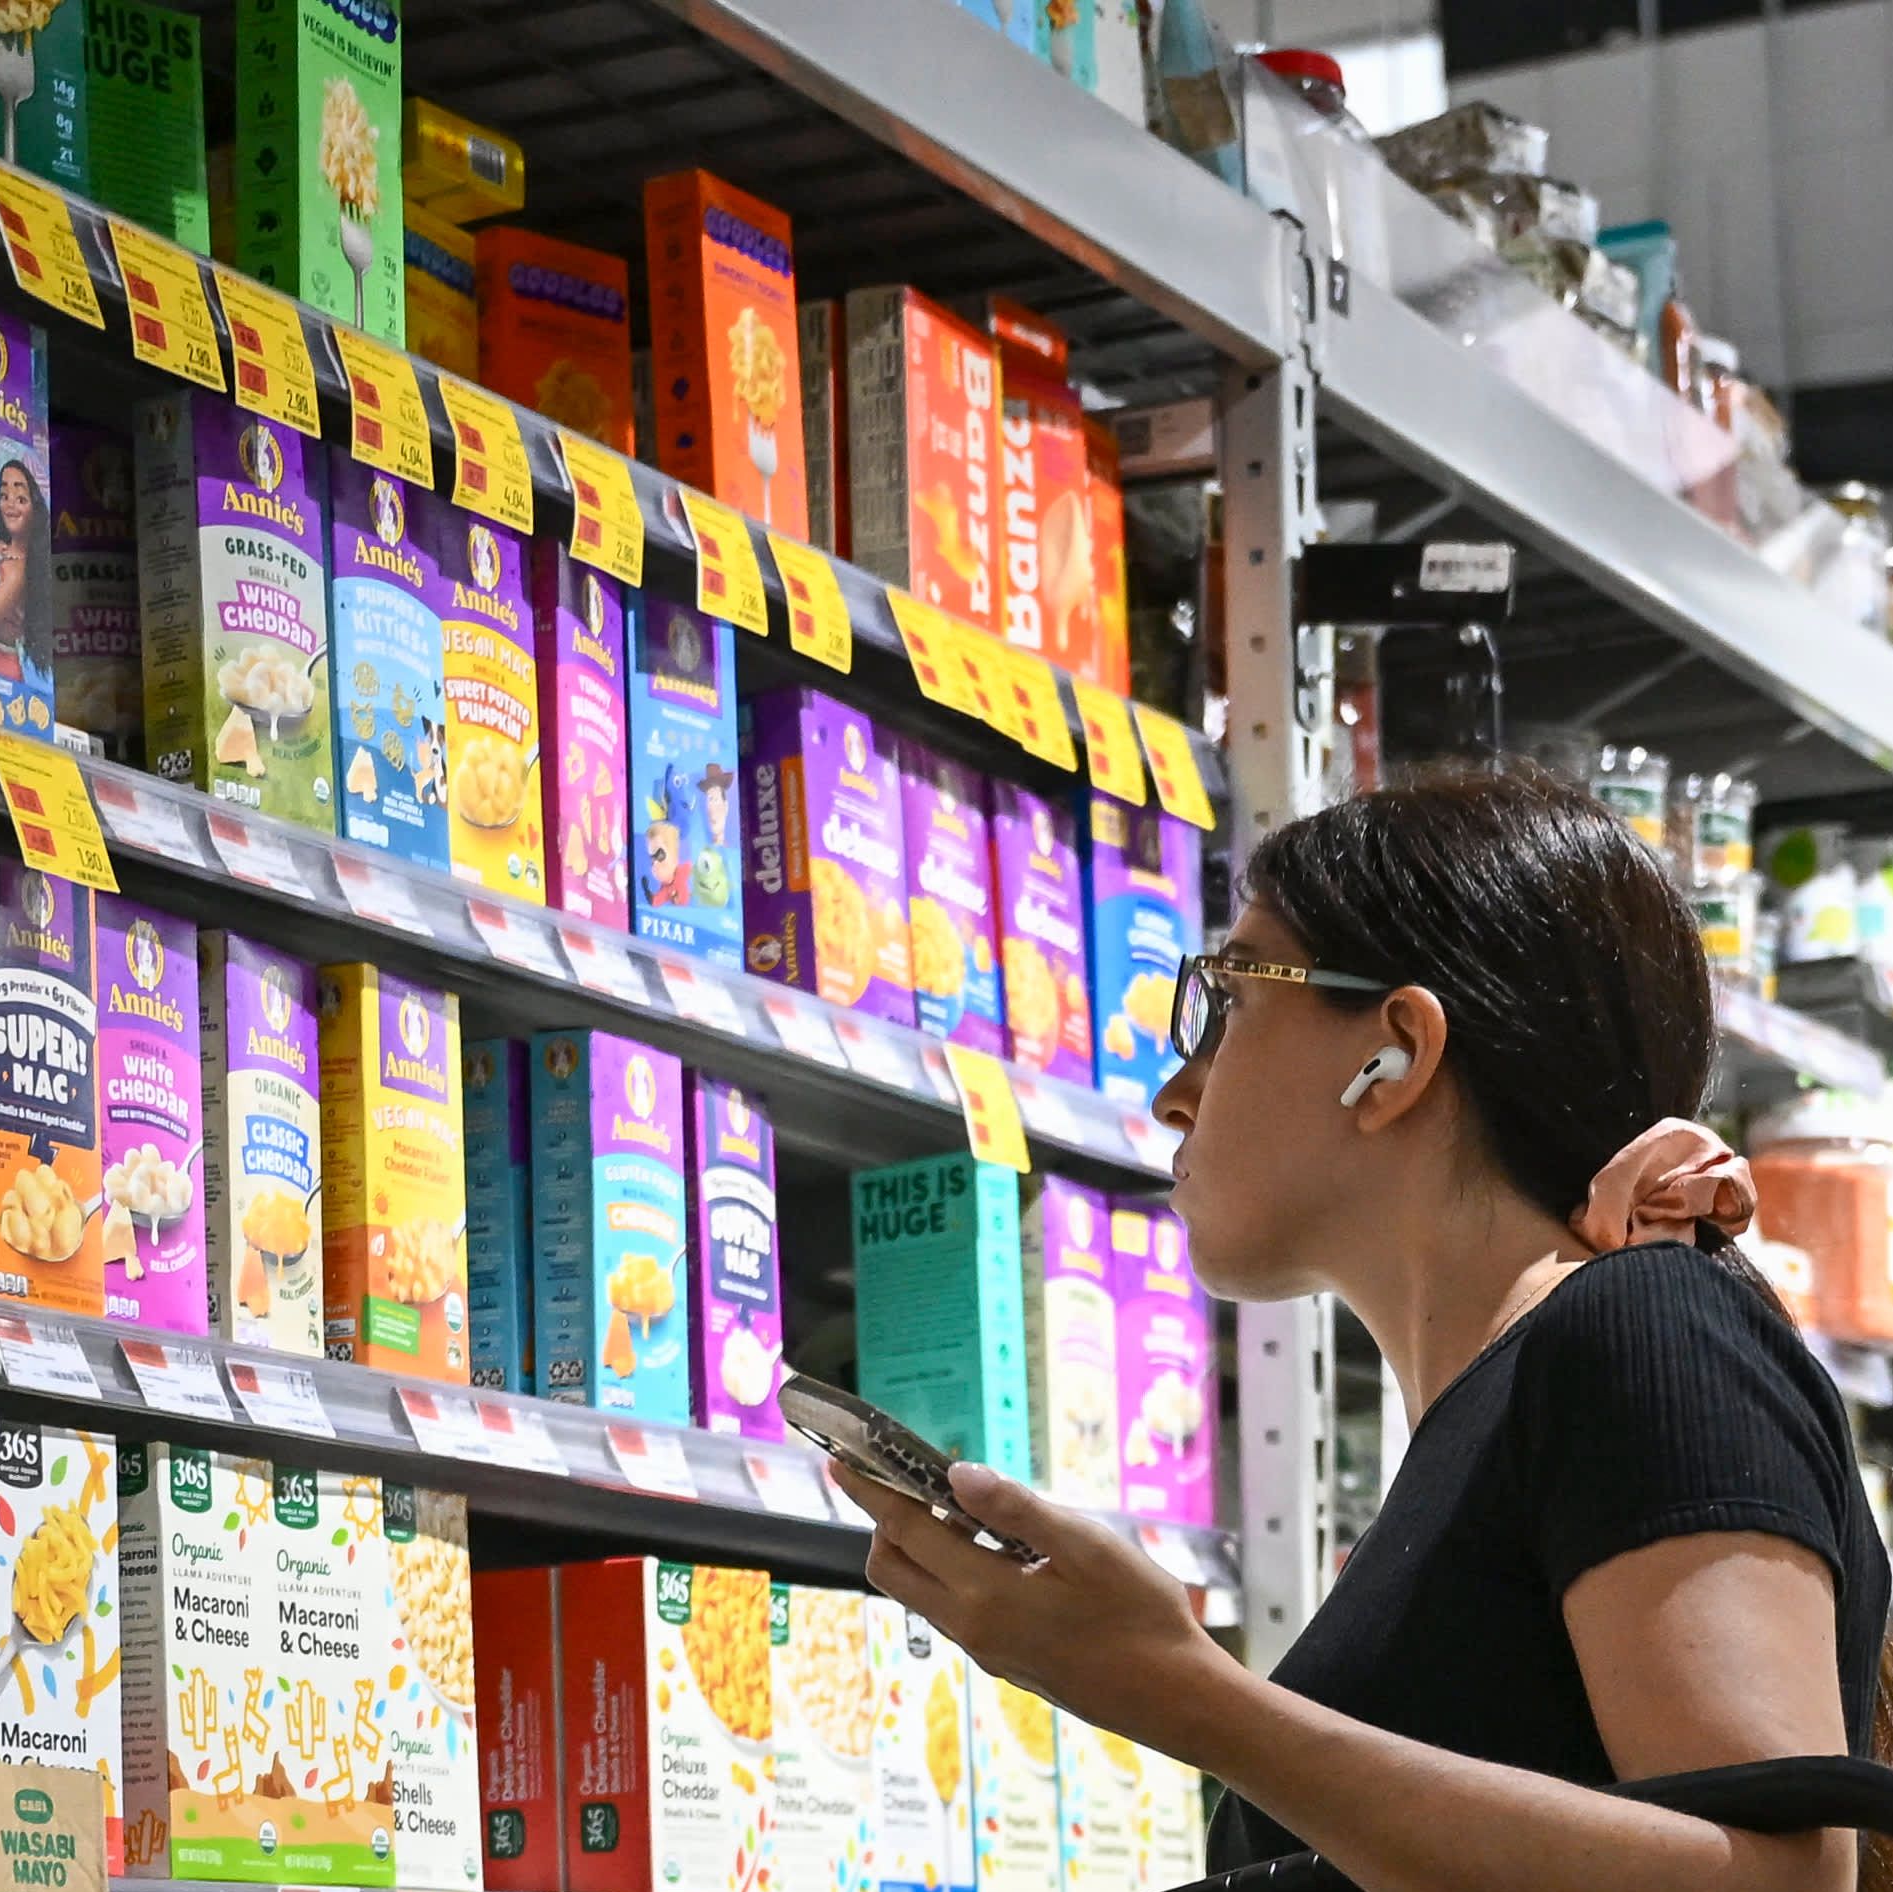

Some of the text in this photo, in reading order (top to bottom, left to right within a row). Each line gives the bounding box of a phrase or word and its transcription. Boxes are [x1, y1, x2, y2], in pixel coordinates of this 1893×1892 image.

[303, 13, 334, 43] VEGAN
[400, 442, 424, 467] 4.04
[504, 485, 526, 509] 4.04
[963, 347, 991, 615] Banza
[223, 482, 305, 537] Annie's
[1004, 397, 1042, 651] Banza
[225, 536, 308, 580] GRASS-FED
[356, 536, 424, 589] Annie's
[453, 583, 519, 631] Annie's
[443, 629, 533, 679] VEGAN MAC
[445, 677, 487, 705] SWEET
[487, 685, 532, 728] POTATO
[8, 921, 72, 963] Annie's
[641, 918, 696, 945] PIXAR
[107, 984, 184, 1034] Annie's
[246, 1030, 307, 1075] Annie's
[13, 1063, 69, 1105] MAC
[860, 1164, 967, 1212] THIS IS
[860, 1204, 947, 1247] HUGE
[0, 1429, 39, 1464] 365
[174, 1457, 208, 1490] 365
[172, 1533, 224, 1564] Organic
[276, 1549, 331, 1578] Organic
[173, 1586, 250, 1619] Macaroni
[659, 1569, 689, 1603] 365
[175, 1618, 250, 1649] & Cheese
[279, 1601, 360, 1633] Macaroni
[280, 1631, 360, 1660] & Cheese
[1, 1723, 88, 1754] Macaroni
[661, 1753, 708, 1778] Deluxe
[392, 1779, 434, 1808] Shells
[661, 1779, 720, 1804] Cheddar
[393, 1809, 457, 1837] & Cheese
[1, 1829, 76, 1860] WASABI
[13, 1860, 66, 1888] MAYO
